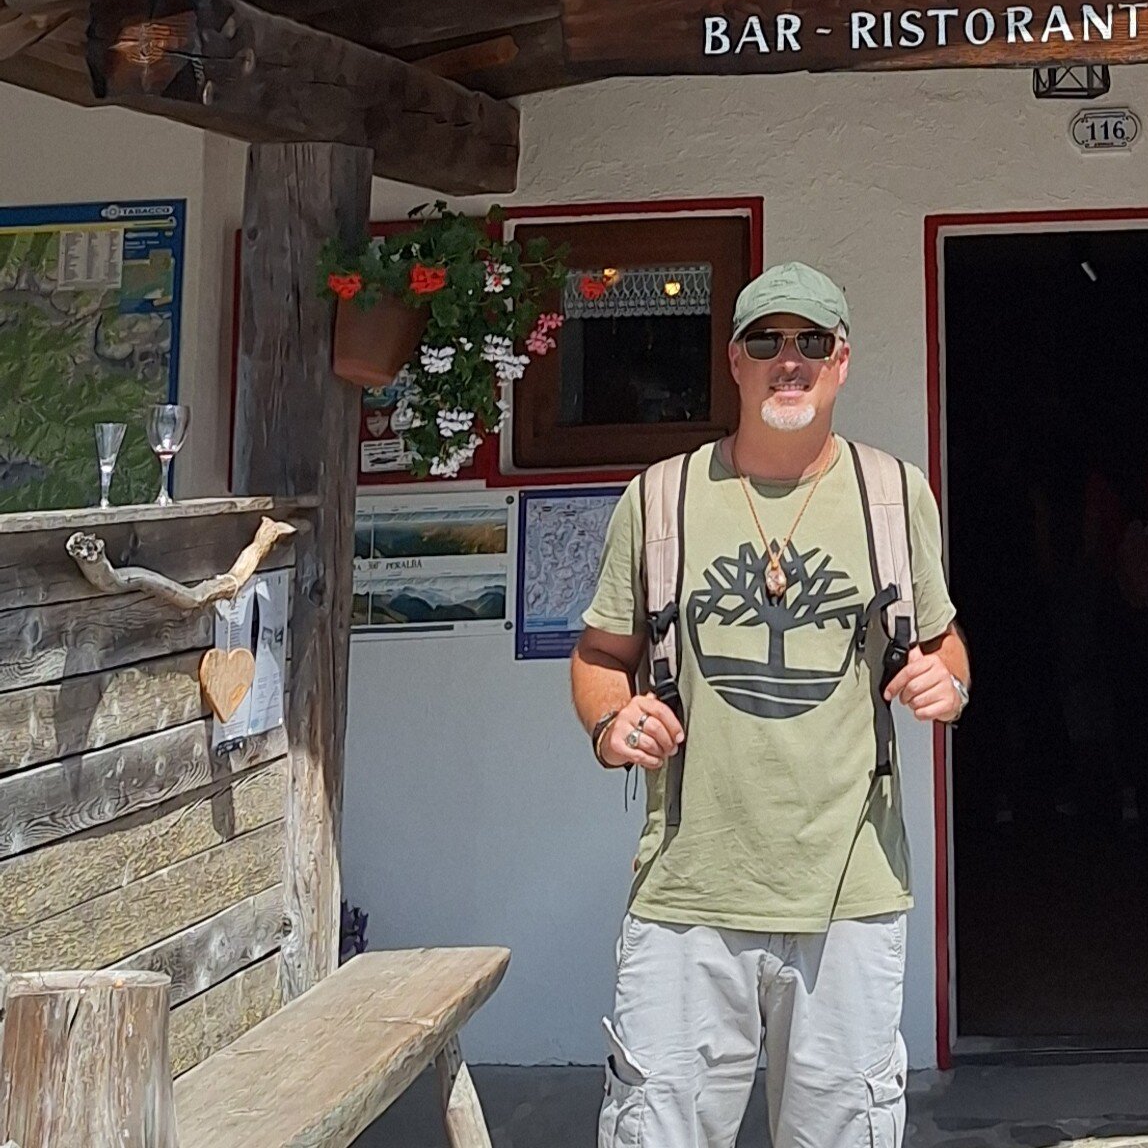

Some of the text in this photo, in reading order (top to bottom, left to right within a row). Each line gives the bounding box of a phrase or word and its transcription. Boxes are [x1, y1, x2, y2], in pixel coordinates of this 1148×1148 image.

[704, 14, 802, 54] BAR
[1086, 120, 1126, 140] 116
[123, 206, 170, 215] TABACCO
